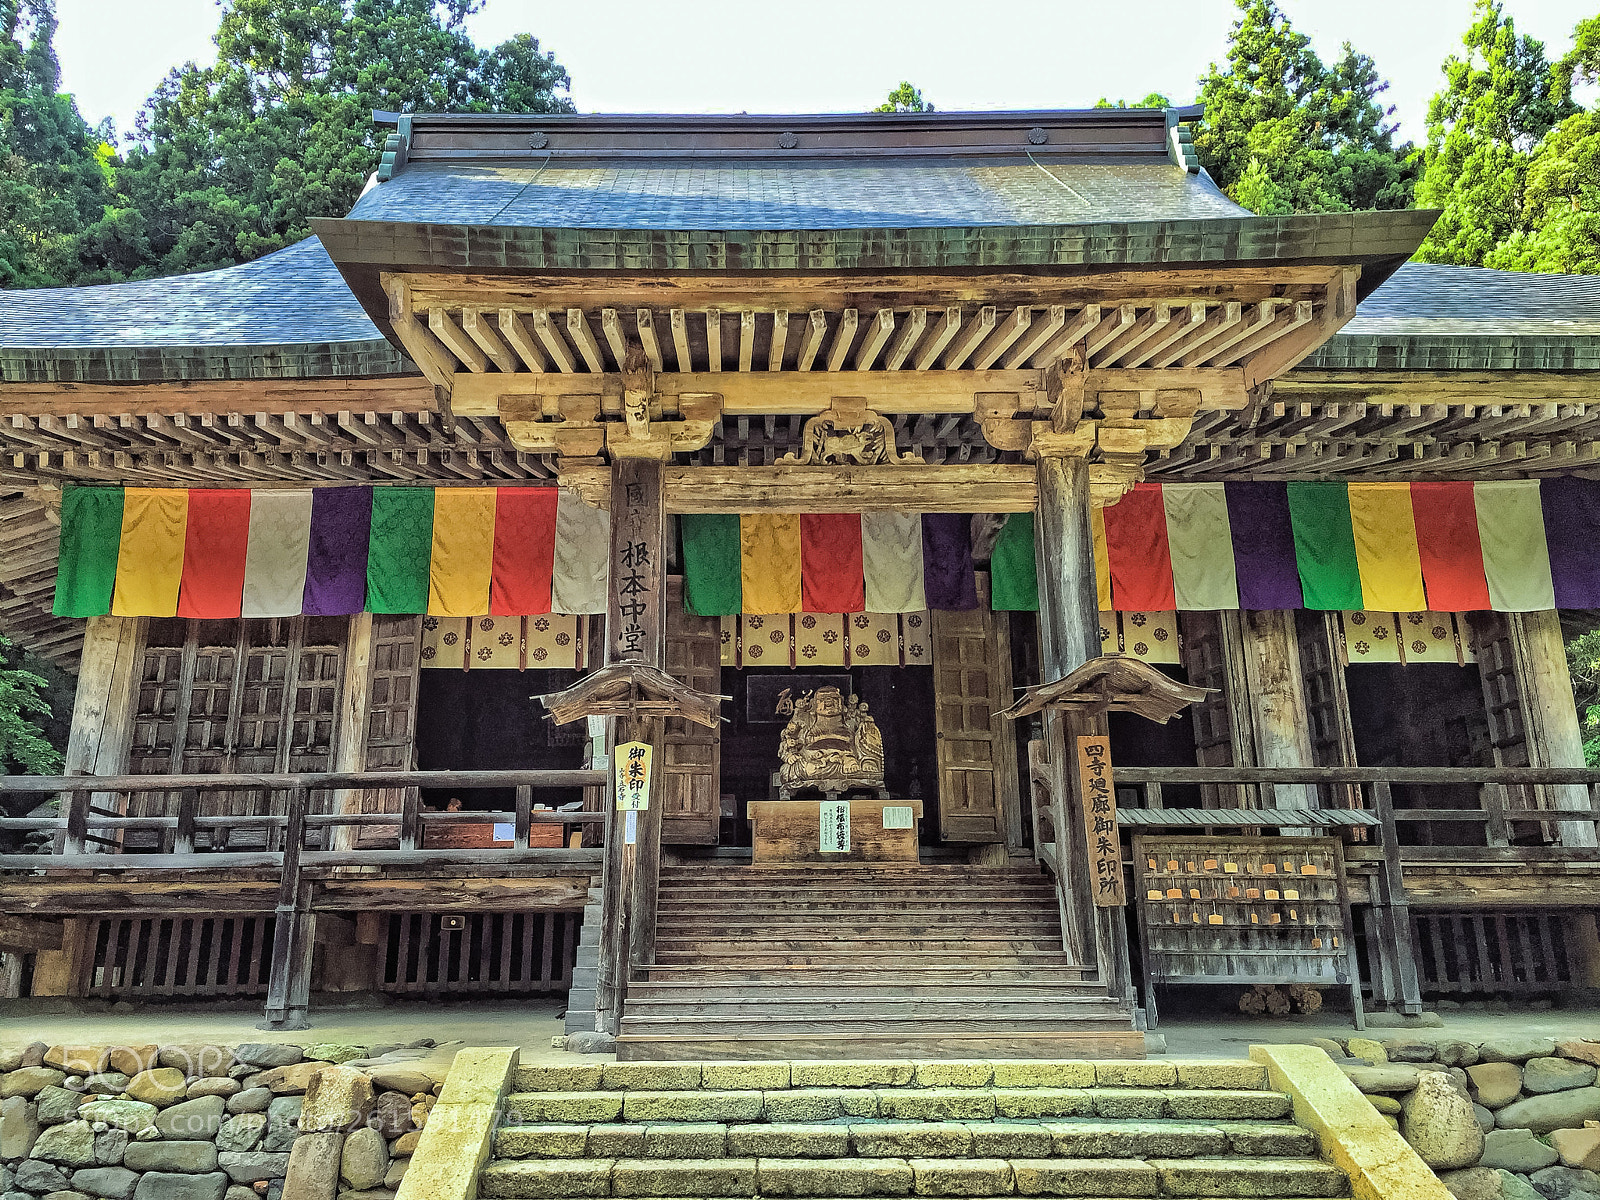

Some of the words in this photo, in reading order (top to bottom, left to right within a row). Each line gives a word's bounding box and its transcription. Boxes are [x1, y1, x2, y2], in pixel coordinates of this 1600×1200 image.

[1084, 744, 1119, 896] 四寺廻廊御朱印所
